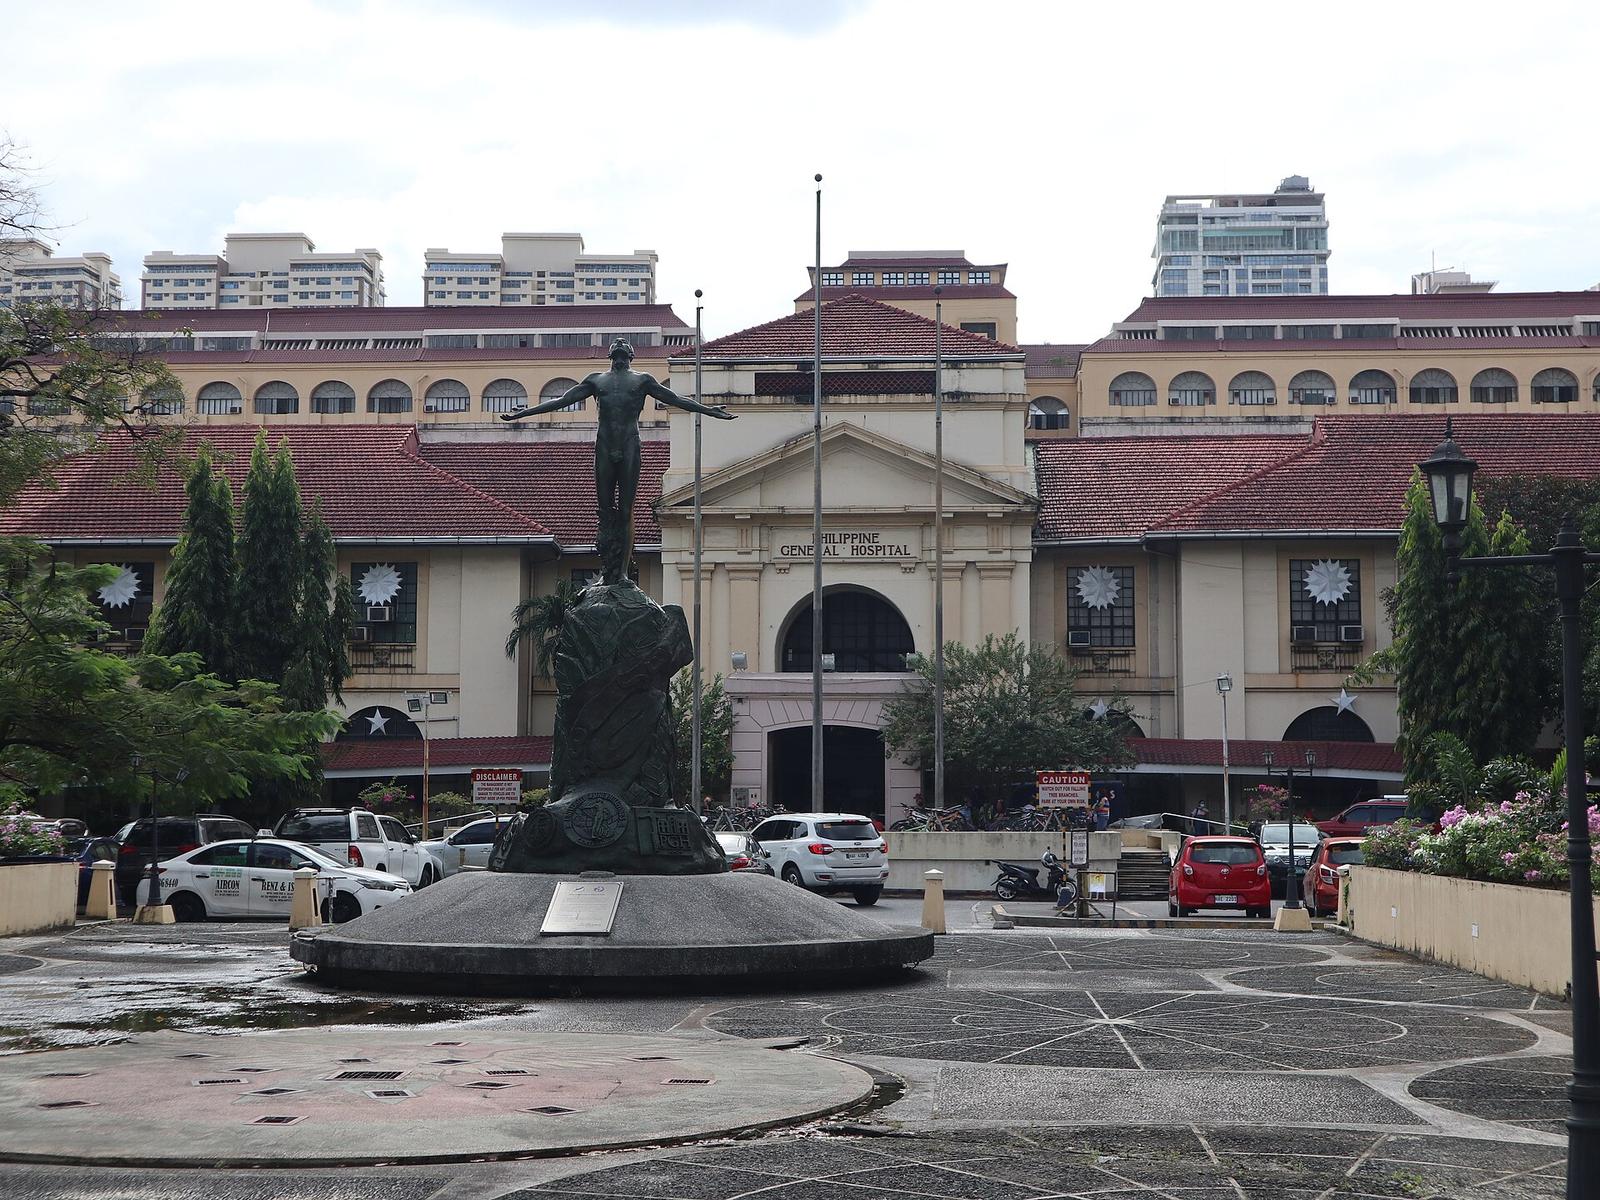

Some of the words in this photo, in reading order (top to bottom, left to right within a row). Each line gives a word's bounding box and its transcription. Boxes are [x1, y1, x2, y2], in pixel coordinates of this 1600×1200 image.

[780, 545, 839, 556] GENEAL
[851, 545, 910, 556] HOSPITAL
[1042, 776, 1085, 784] CAUTION
[660, 836, 690, 848] PGH
[215, 879, 240, 890] AIRCON
[261, 881, 279, 891] RENZ
[280, 881, 286, 891] &
